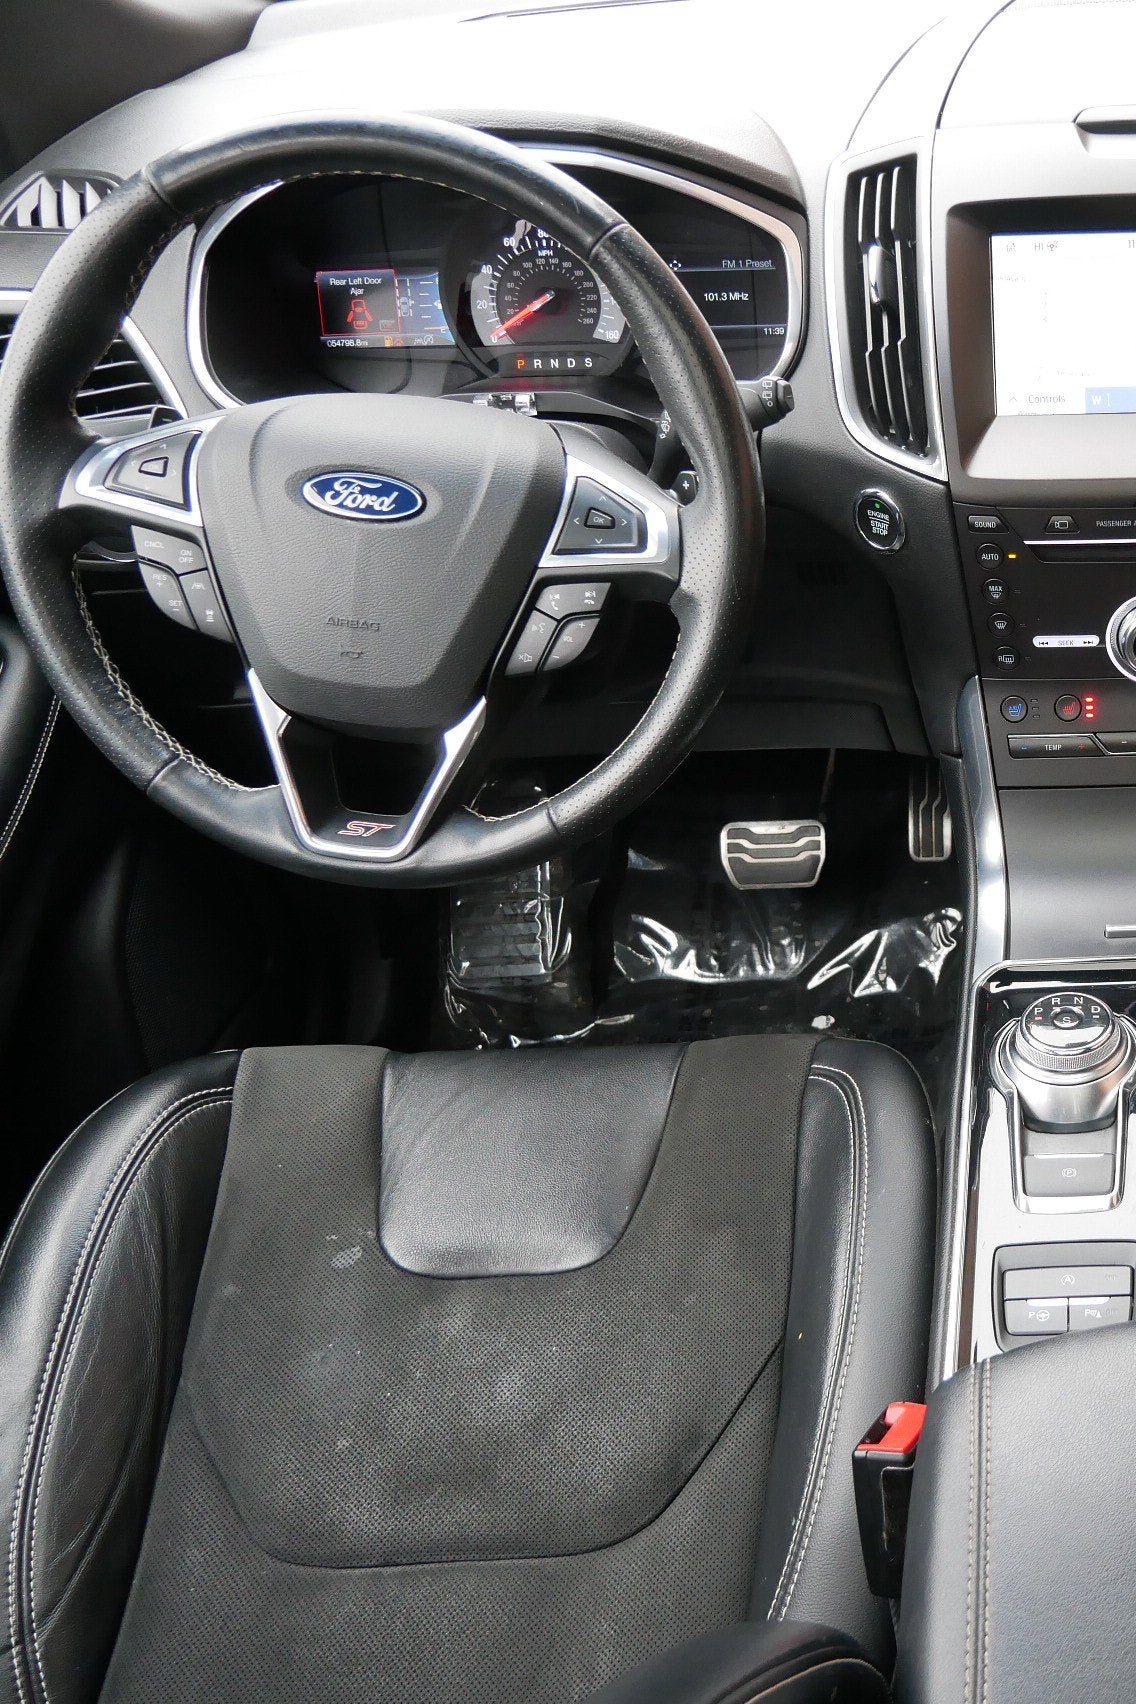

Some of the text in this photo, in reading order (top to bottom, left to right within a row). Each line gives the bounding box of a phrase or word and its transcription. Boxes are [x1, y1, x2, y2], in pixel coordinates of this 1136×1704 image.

[503, 237, 516, 247] 60
[522, 261, 533, 269] 100
[722, 260, 736, 268] FM
[745, 259, 772, 268] Preset
[481, 265, 493, 275] 40
[329, 277, 382, 286] Rear Left Door
[350, 288, 365, 296] Ajar
[704, 292, 749, 301] 101.3 MHz
[476, 300, 487, 309] 20
[604, 330, 619, 340] 160
[763, 327, 785, 335] 11:39
[517, 357, 593, 369] P R N D S
[1028, 394, 1066, 404] Controls
[324, 478, 399, 512] Ford
[867, 509, 890, 520] ENGINE
[593, 516, 605, 524] OK
[974, 521, 996, 529] SOUND
[981, 553, 999, 561] AUTO
[326, 616, 381, 632] AIRBAG
[1044, 743, 1062, 751] TEMP
[337, 820, 396, 837] ST
[1073, 996, 1084, 1005] N
[1034, 1007, 1043, 1015] P
[1091, 1005, 1101, 1013] D
[1062, 1016, 1071, 1024] S
